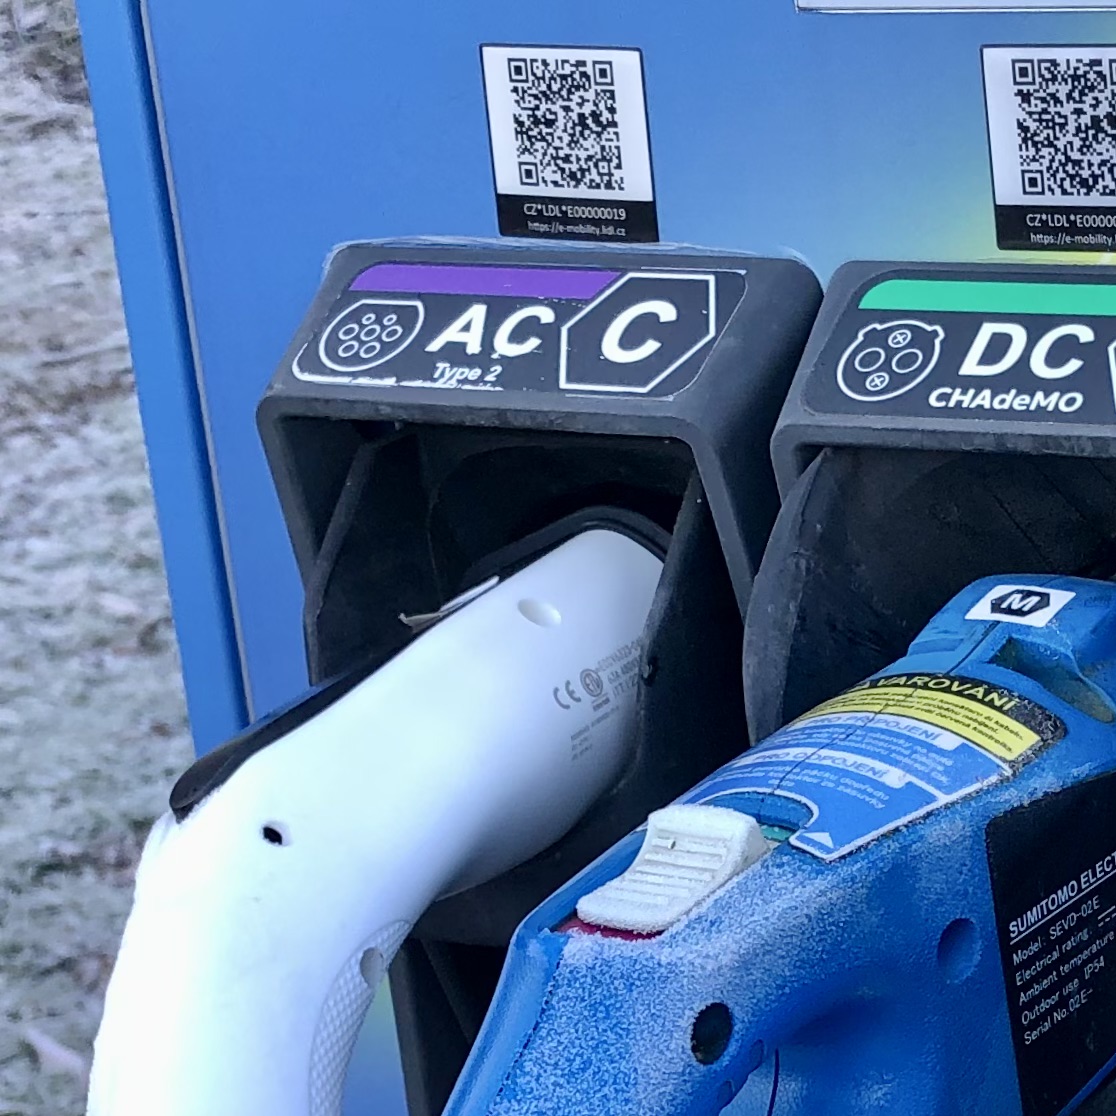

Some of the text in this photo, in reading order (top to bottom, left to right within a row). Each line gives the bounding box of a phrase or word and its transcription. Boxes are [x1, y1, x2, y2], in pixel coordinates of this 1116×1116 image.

[424, 303, 555, 358] AC
[600, 300, 677, 364] C
[958, 321, 1095, 379] DC
[432, 362, 503, 385] Type 2
[928, 386, 1084, 413] CHAdeMO
[1000, 592, 1040, 611] M
[1008, 880, 1079, 938] SUMITOMO
[1015, 944, 1060, 986] Electrical
[1019, 970, 1059, 1007] Ambient
[1059, 931, 1115, 976] temperature
[1021, 954, 1105, 1025] Outdoor use IP54
[1023, 1015, 1052, 1046] Serial
